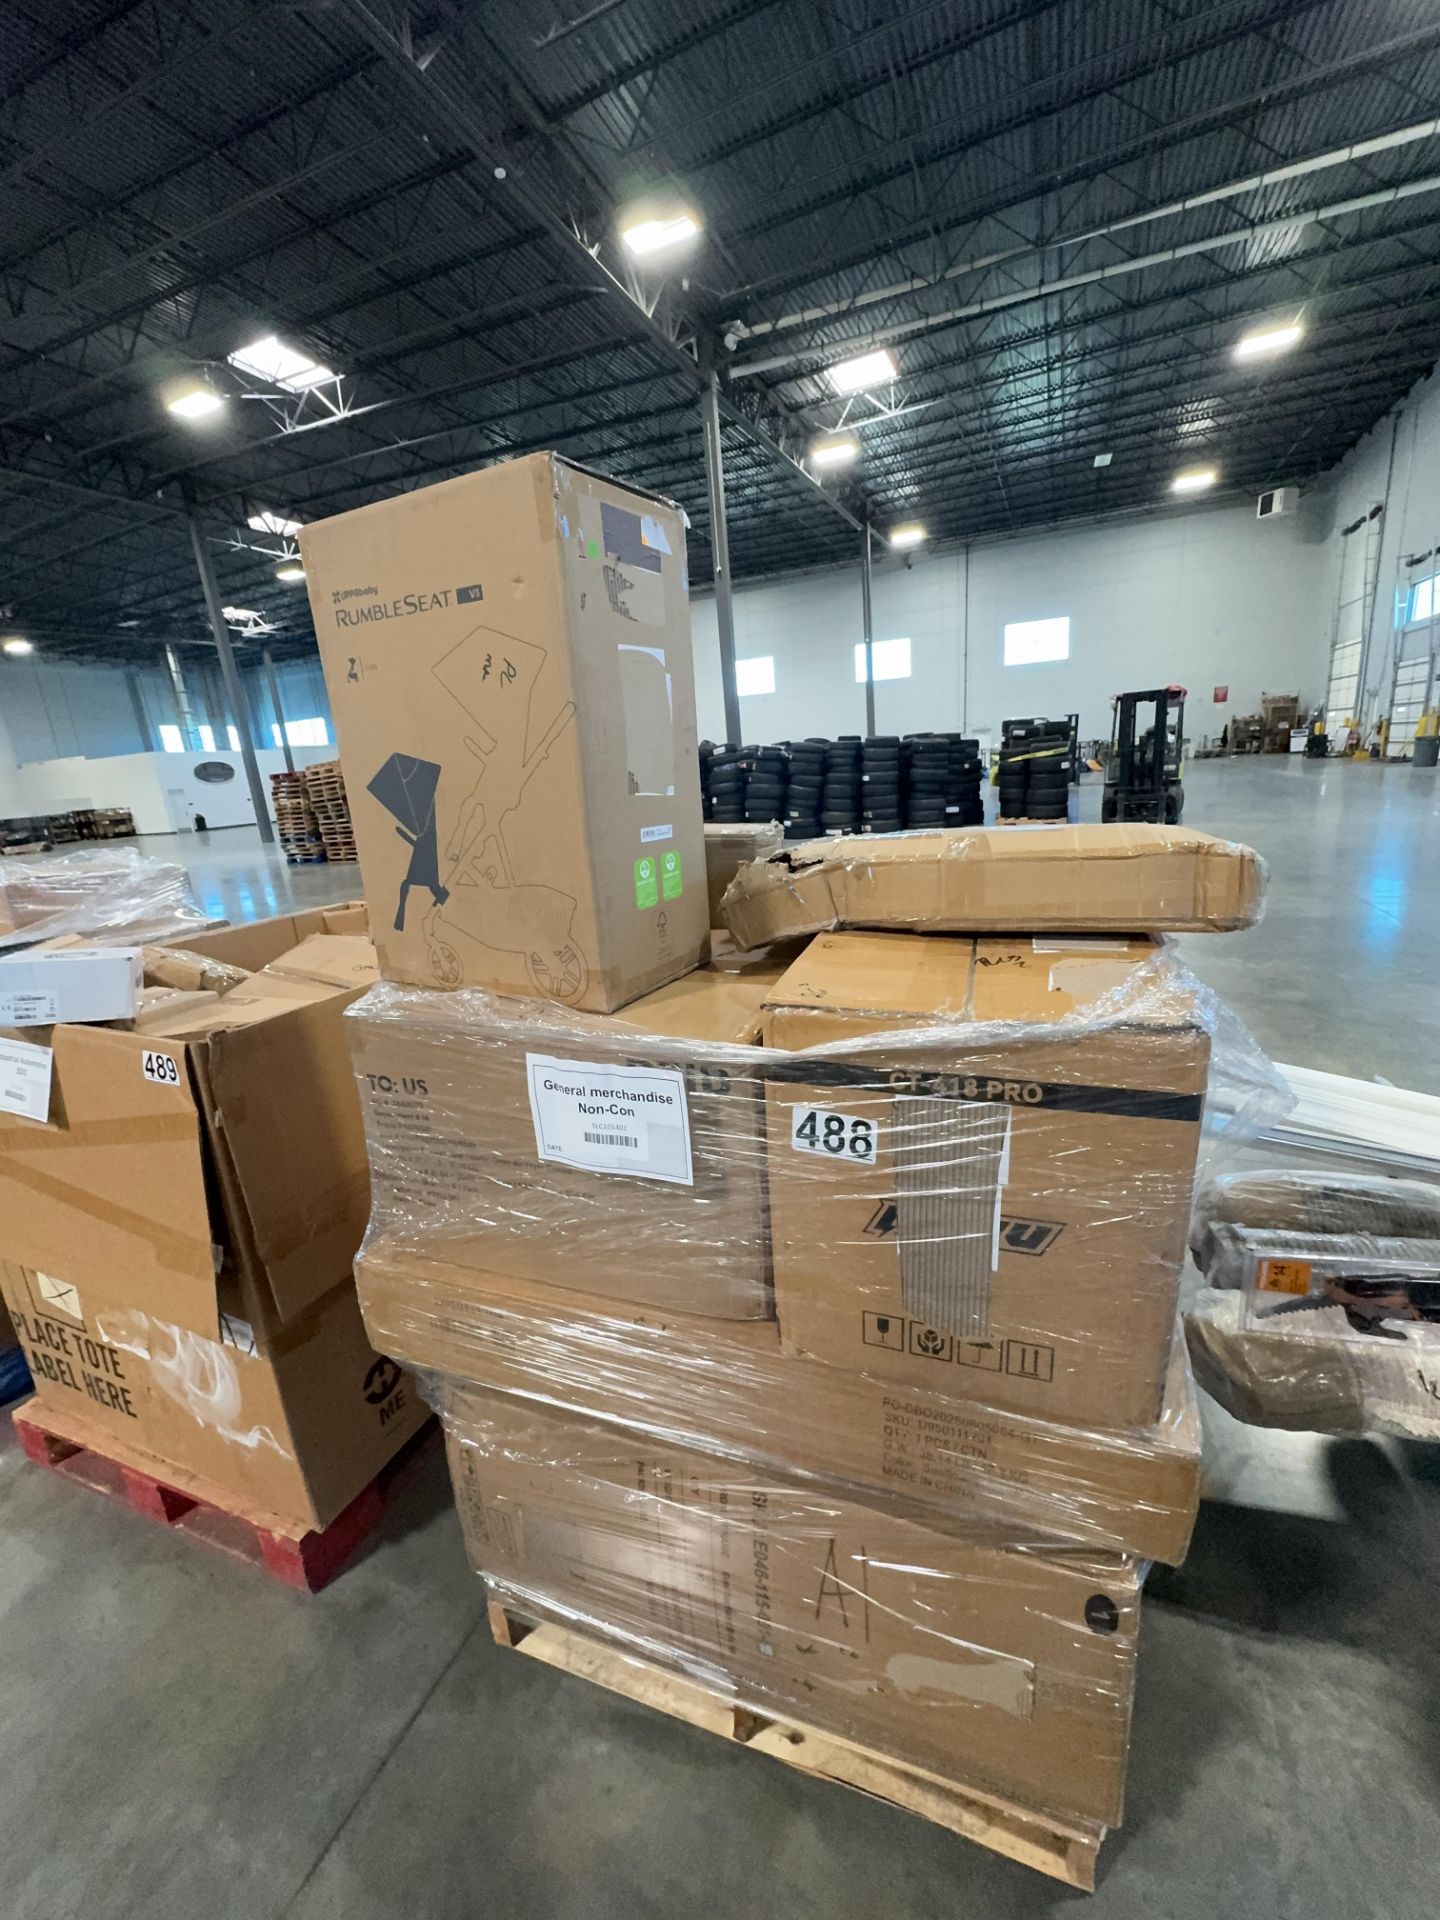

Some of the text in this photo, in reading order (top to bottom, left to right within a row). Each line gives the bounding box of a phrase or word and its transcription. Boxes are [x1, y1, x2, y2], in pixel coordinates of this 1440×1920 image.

[145, 1053, 178, 1082] 489
[366, 1073, 429, 1096] TO: US
[543, 1079, 674, 1105] General merchandise
[986, 1080, 1043, 1104] PRO
[578, 1102, 636, 1118] Non-Con
[795, 1111, 873, 1159] 488
[11, 1310, 126, 1380] PLACE TOTE
[81, 1370, 138, 1419] HERE
[917, 1420, 992, 1445] D95011101
